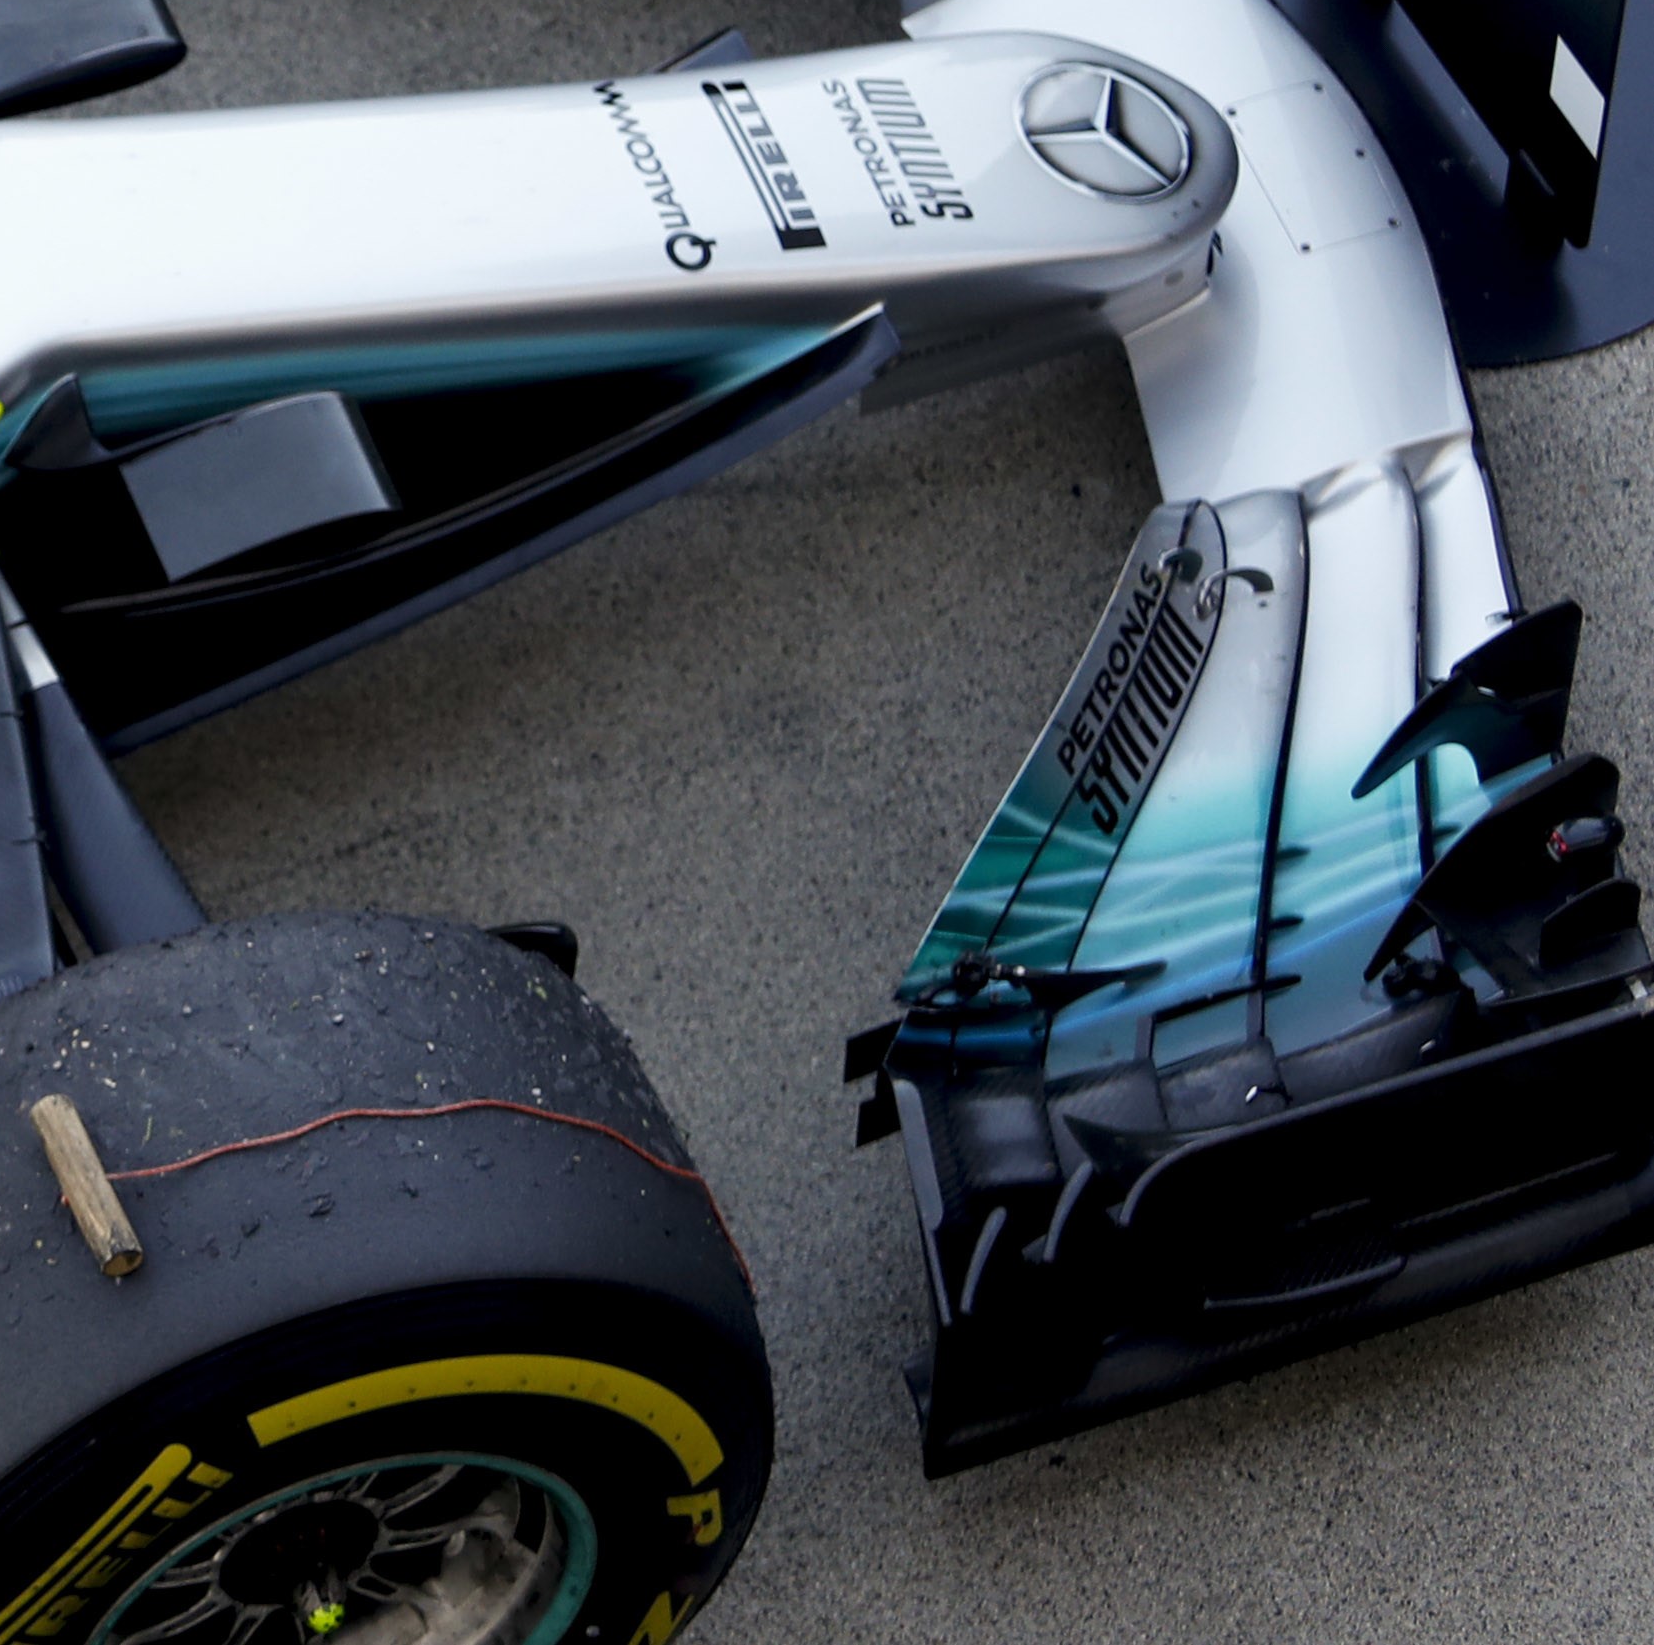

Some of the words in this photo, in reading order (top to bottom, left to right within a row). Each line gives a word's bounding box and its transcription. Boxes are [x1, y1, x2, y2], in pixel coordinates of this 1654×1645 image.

[701, 79, 826, 250] PIRELLI
[823, 79, 915, 227] PETRONAS
[856, 77, 974, 220] SYNTIUM
[1057, 561, 1163, 776] PETRONAS
[1077, 598, 1204, 835] SYNTIUM
